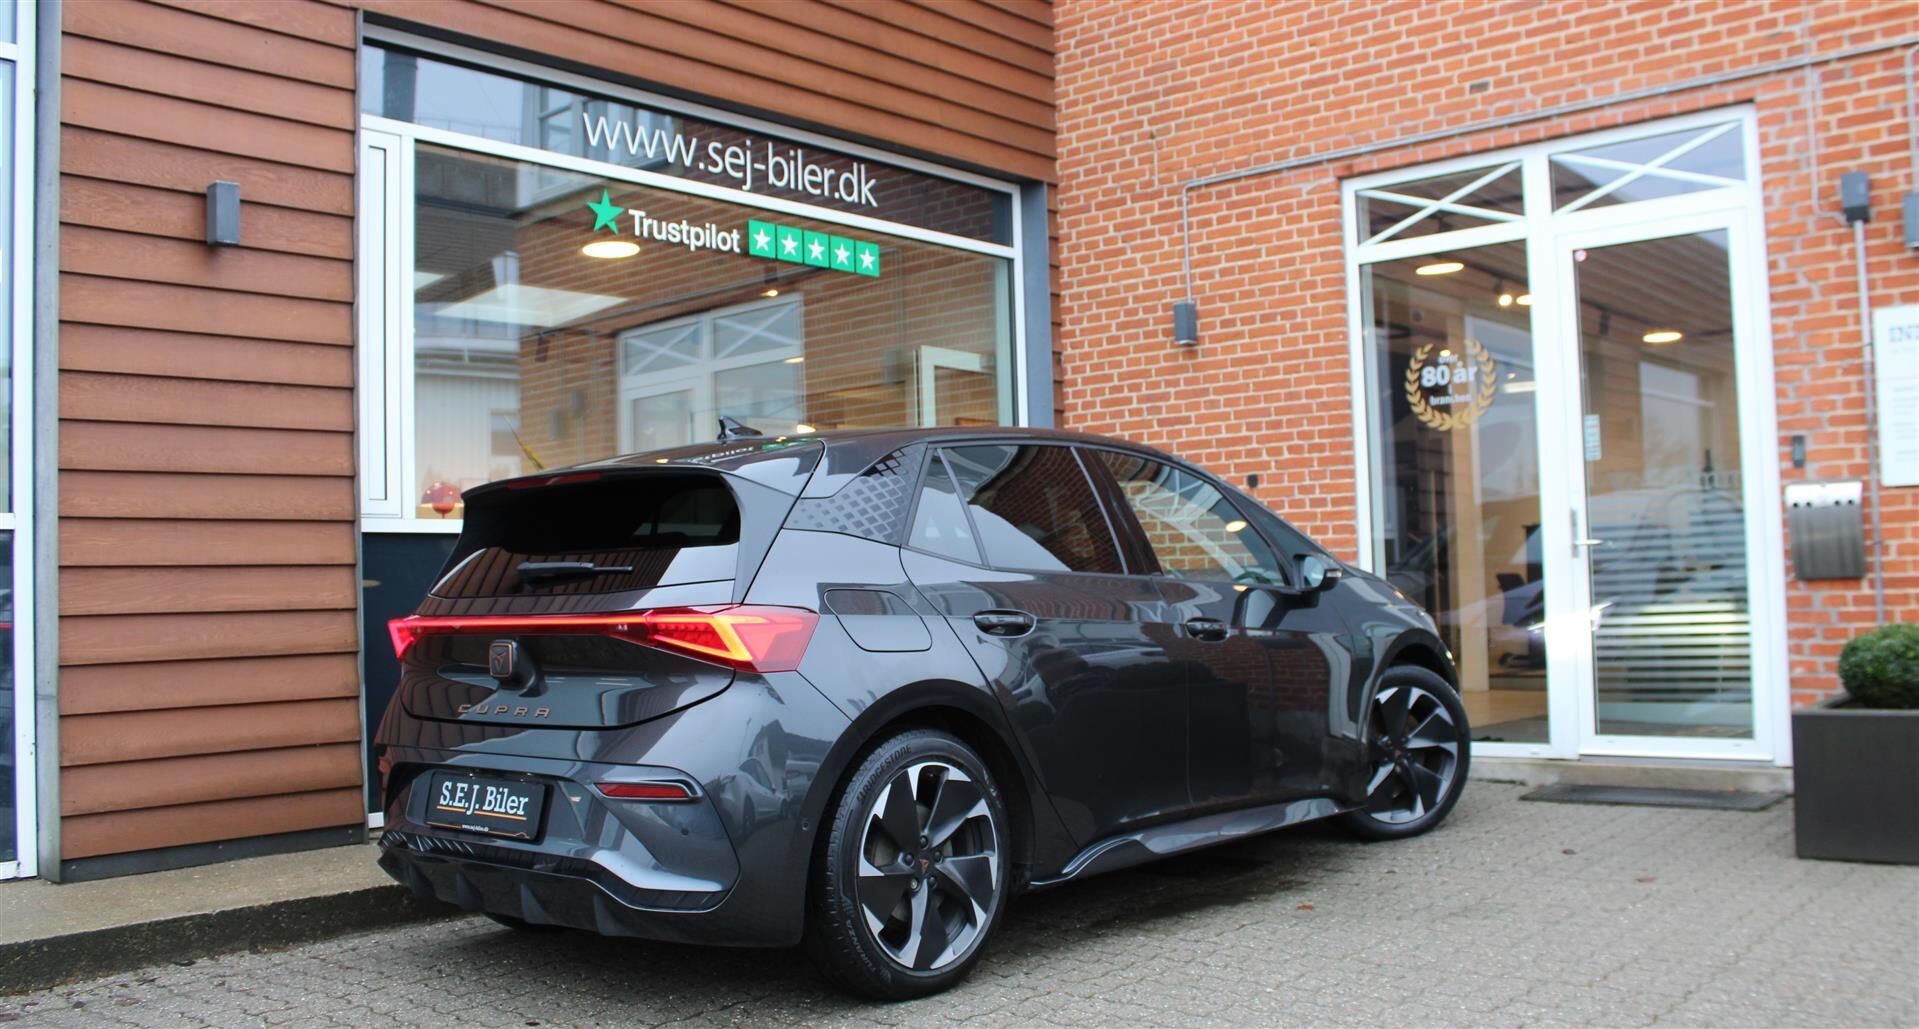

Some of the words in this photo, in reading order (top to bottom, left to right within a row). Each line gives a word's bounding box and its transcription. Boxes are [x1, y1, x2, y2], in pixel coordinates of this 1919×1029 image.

[582, 111, 878, 207] www.sej-biler.dk
[628, 208, 741, 254] Trustpilot
[1421, 366, 1450, 387] 80
[1454, 362, 1477, 383] år
[457, 704, 550, 718] CUPRA
[440, 781, 479, 815] S.E.J.
[483, 786, 529, 815] Biler
